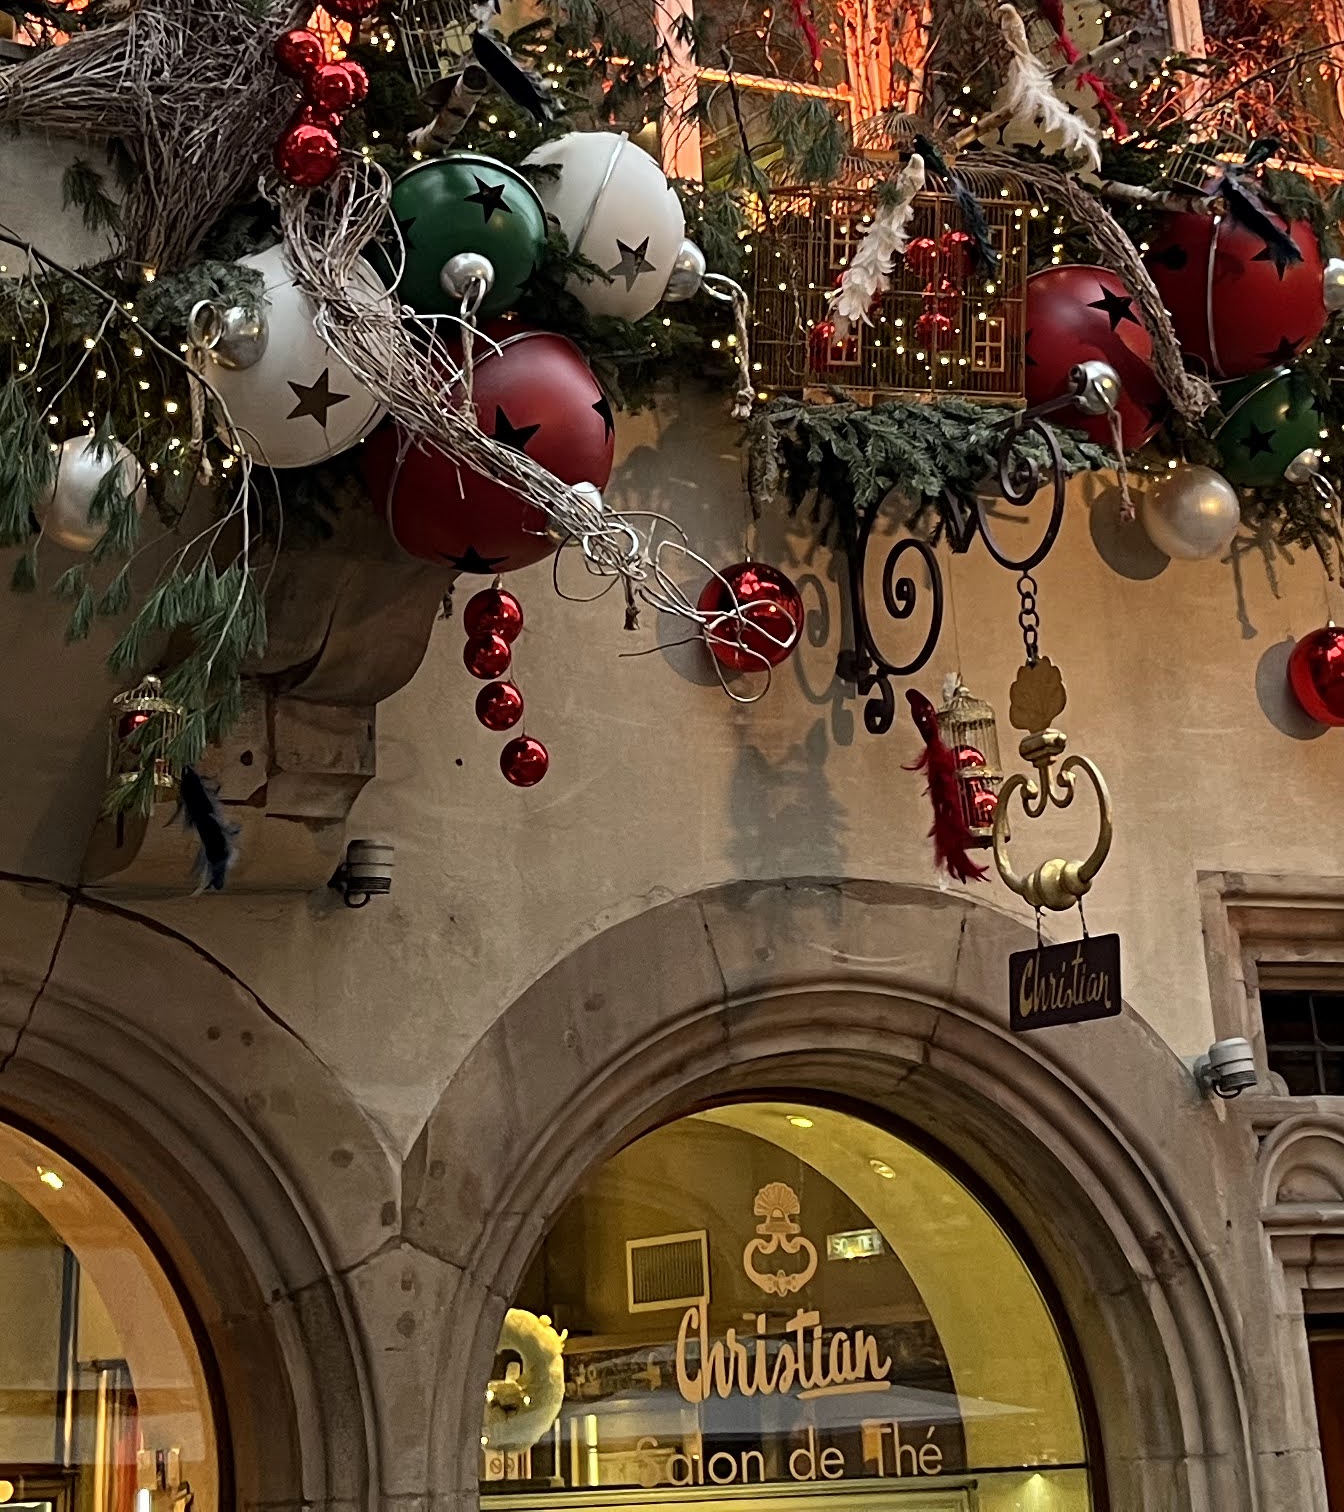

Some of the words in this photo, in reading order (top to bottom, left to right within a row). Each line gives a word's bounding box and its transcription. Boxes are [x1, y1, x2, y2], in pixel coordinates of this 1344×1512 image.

[1019, 942, 1111, 1018] Christian
[832, 1235, 873, 1256] SOTIE
[676, 1302, 893, 1402] Christian
[636, 1430, 765, 1487] Salon
[788, 1425, 845, 1481] de
[868, 1421, 944, 1478] Thé
